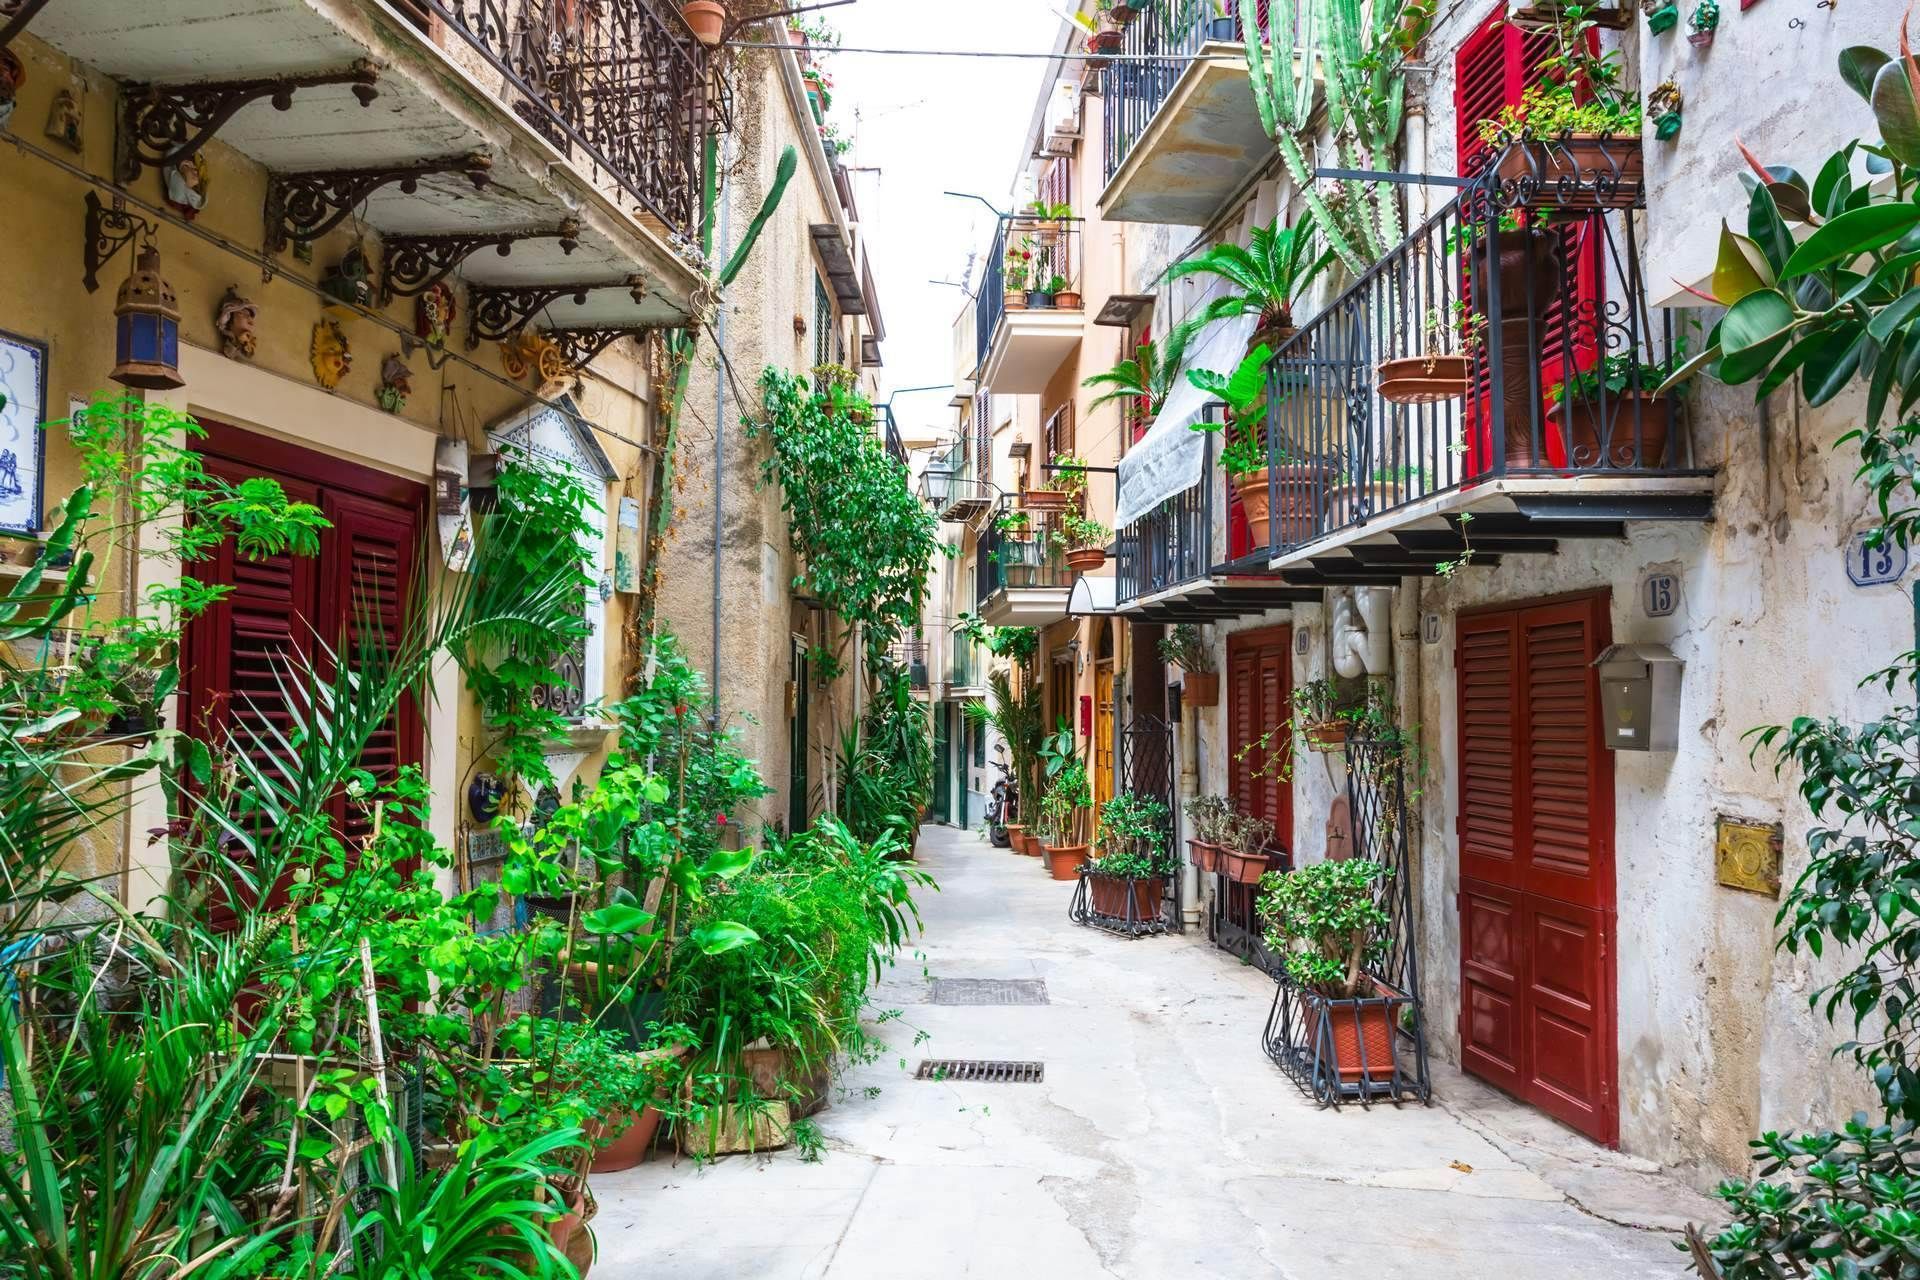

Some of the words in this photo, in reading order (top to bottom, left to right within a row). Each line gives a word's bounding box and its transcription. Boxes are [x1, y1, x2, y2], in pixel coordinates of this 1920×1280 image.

[1859, 540, 1893, 578] 13
[1651, 578, 1671, 611] 15
[1427, 616, 1438, 639] 17
[1299, 633, 1307, 651] 19
